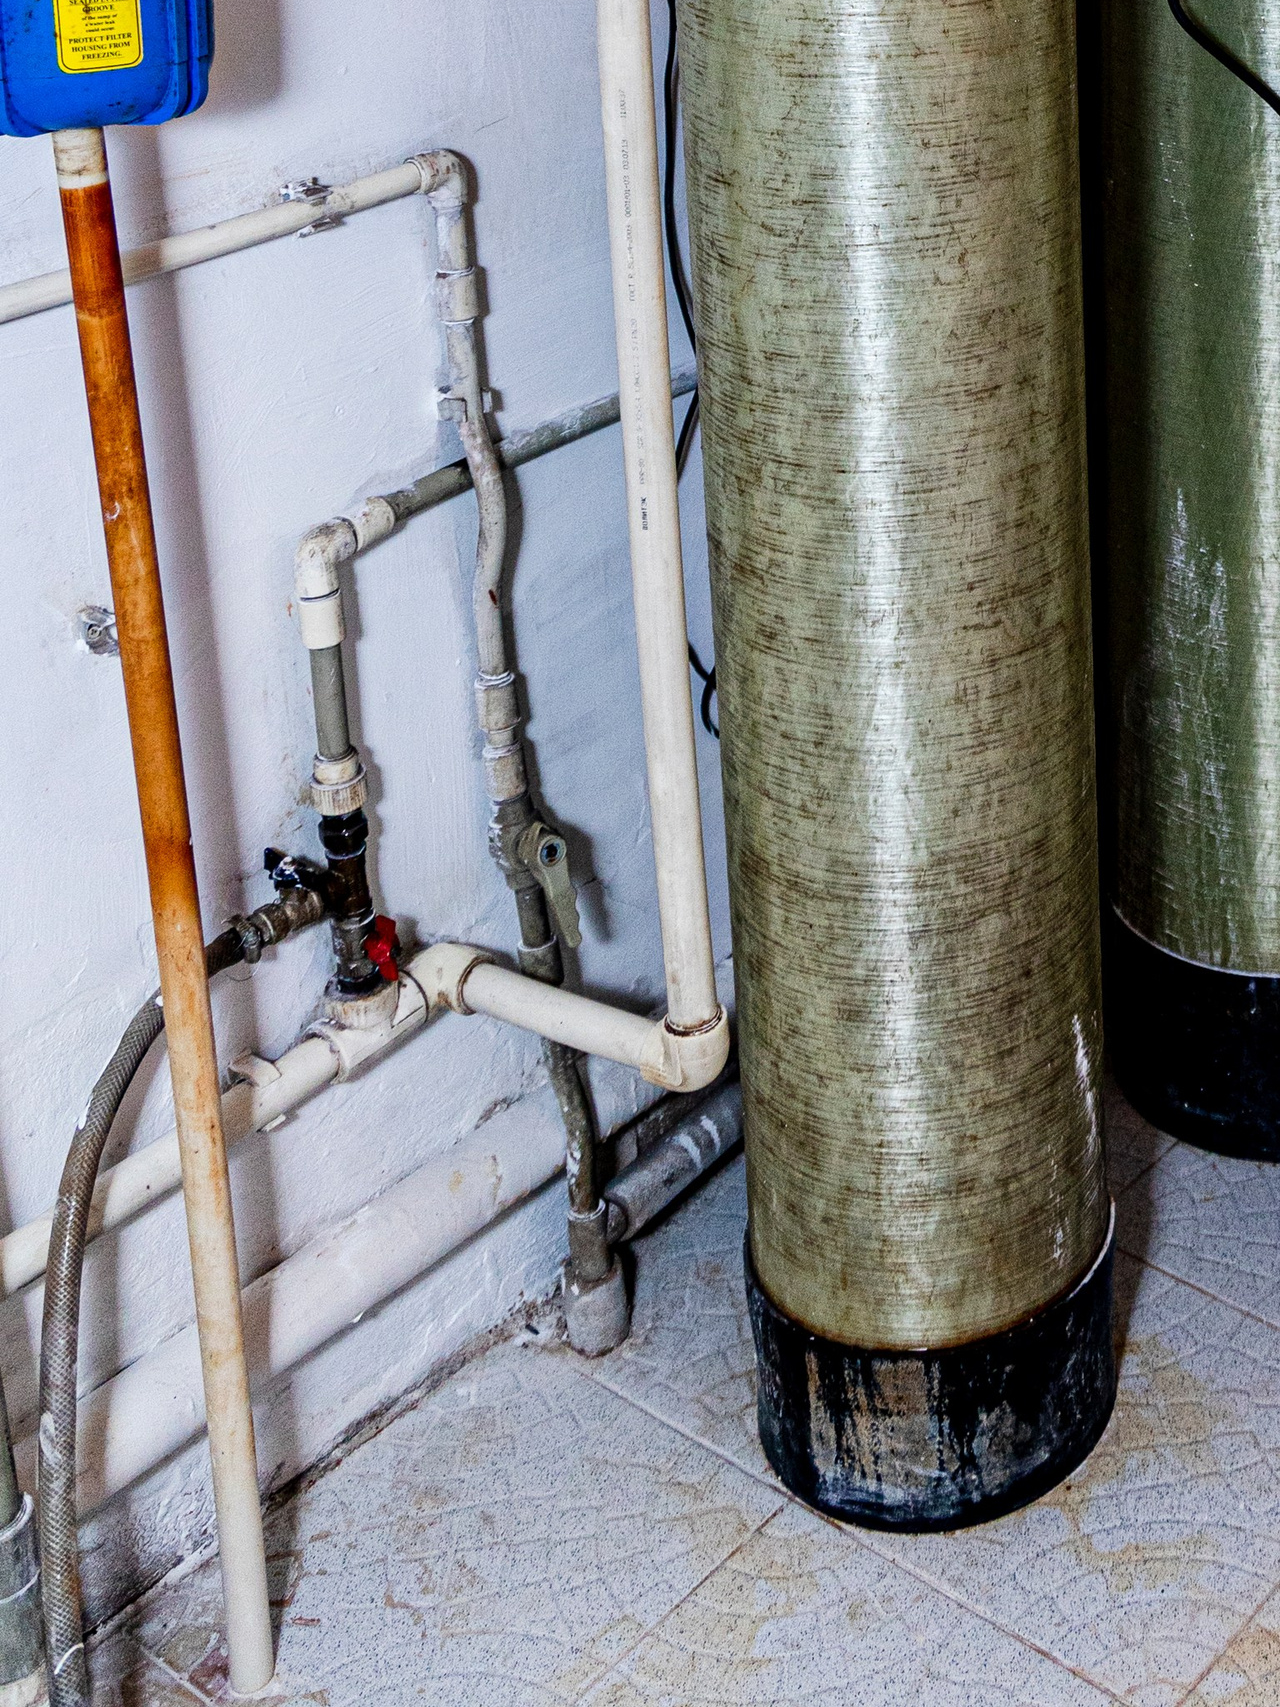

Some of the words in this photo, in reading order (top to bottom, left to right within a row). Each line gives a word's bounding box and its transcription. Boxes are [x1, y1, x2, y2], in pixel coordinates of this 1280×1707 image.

[82, 4, 115, 13] GROOVE
[68, 35, 105, 45] PROTECT
[106, 32, 132, 41] FILTER
[71, 44, 108, 53] HOUSING
[109, 41, 131, 49] FROM
